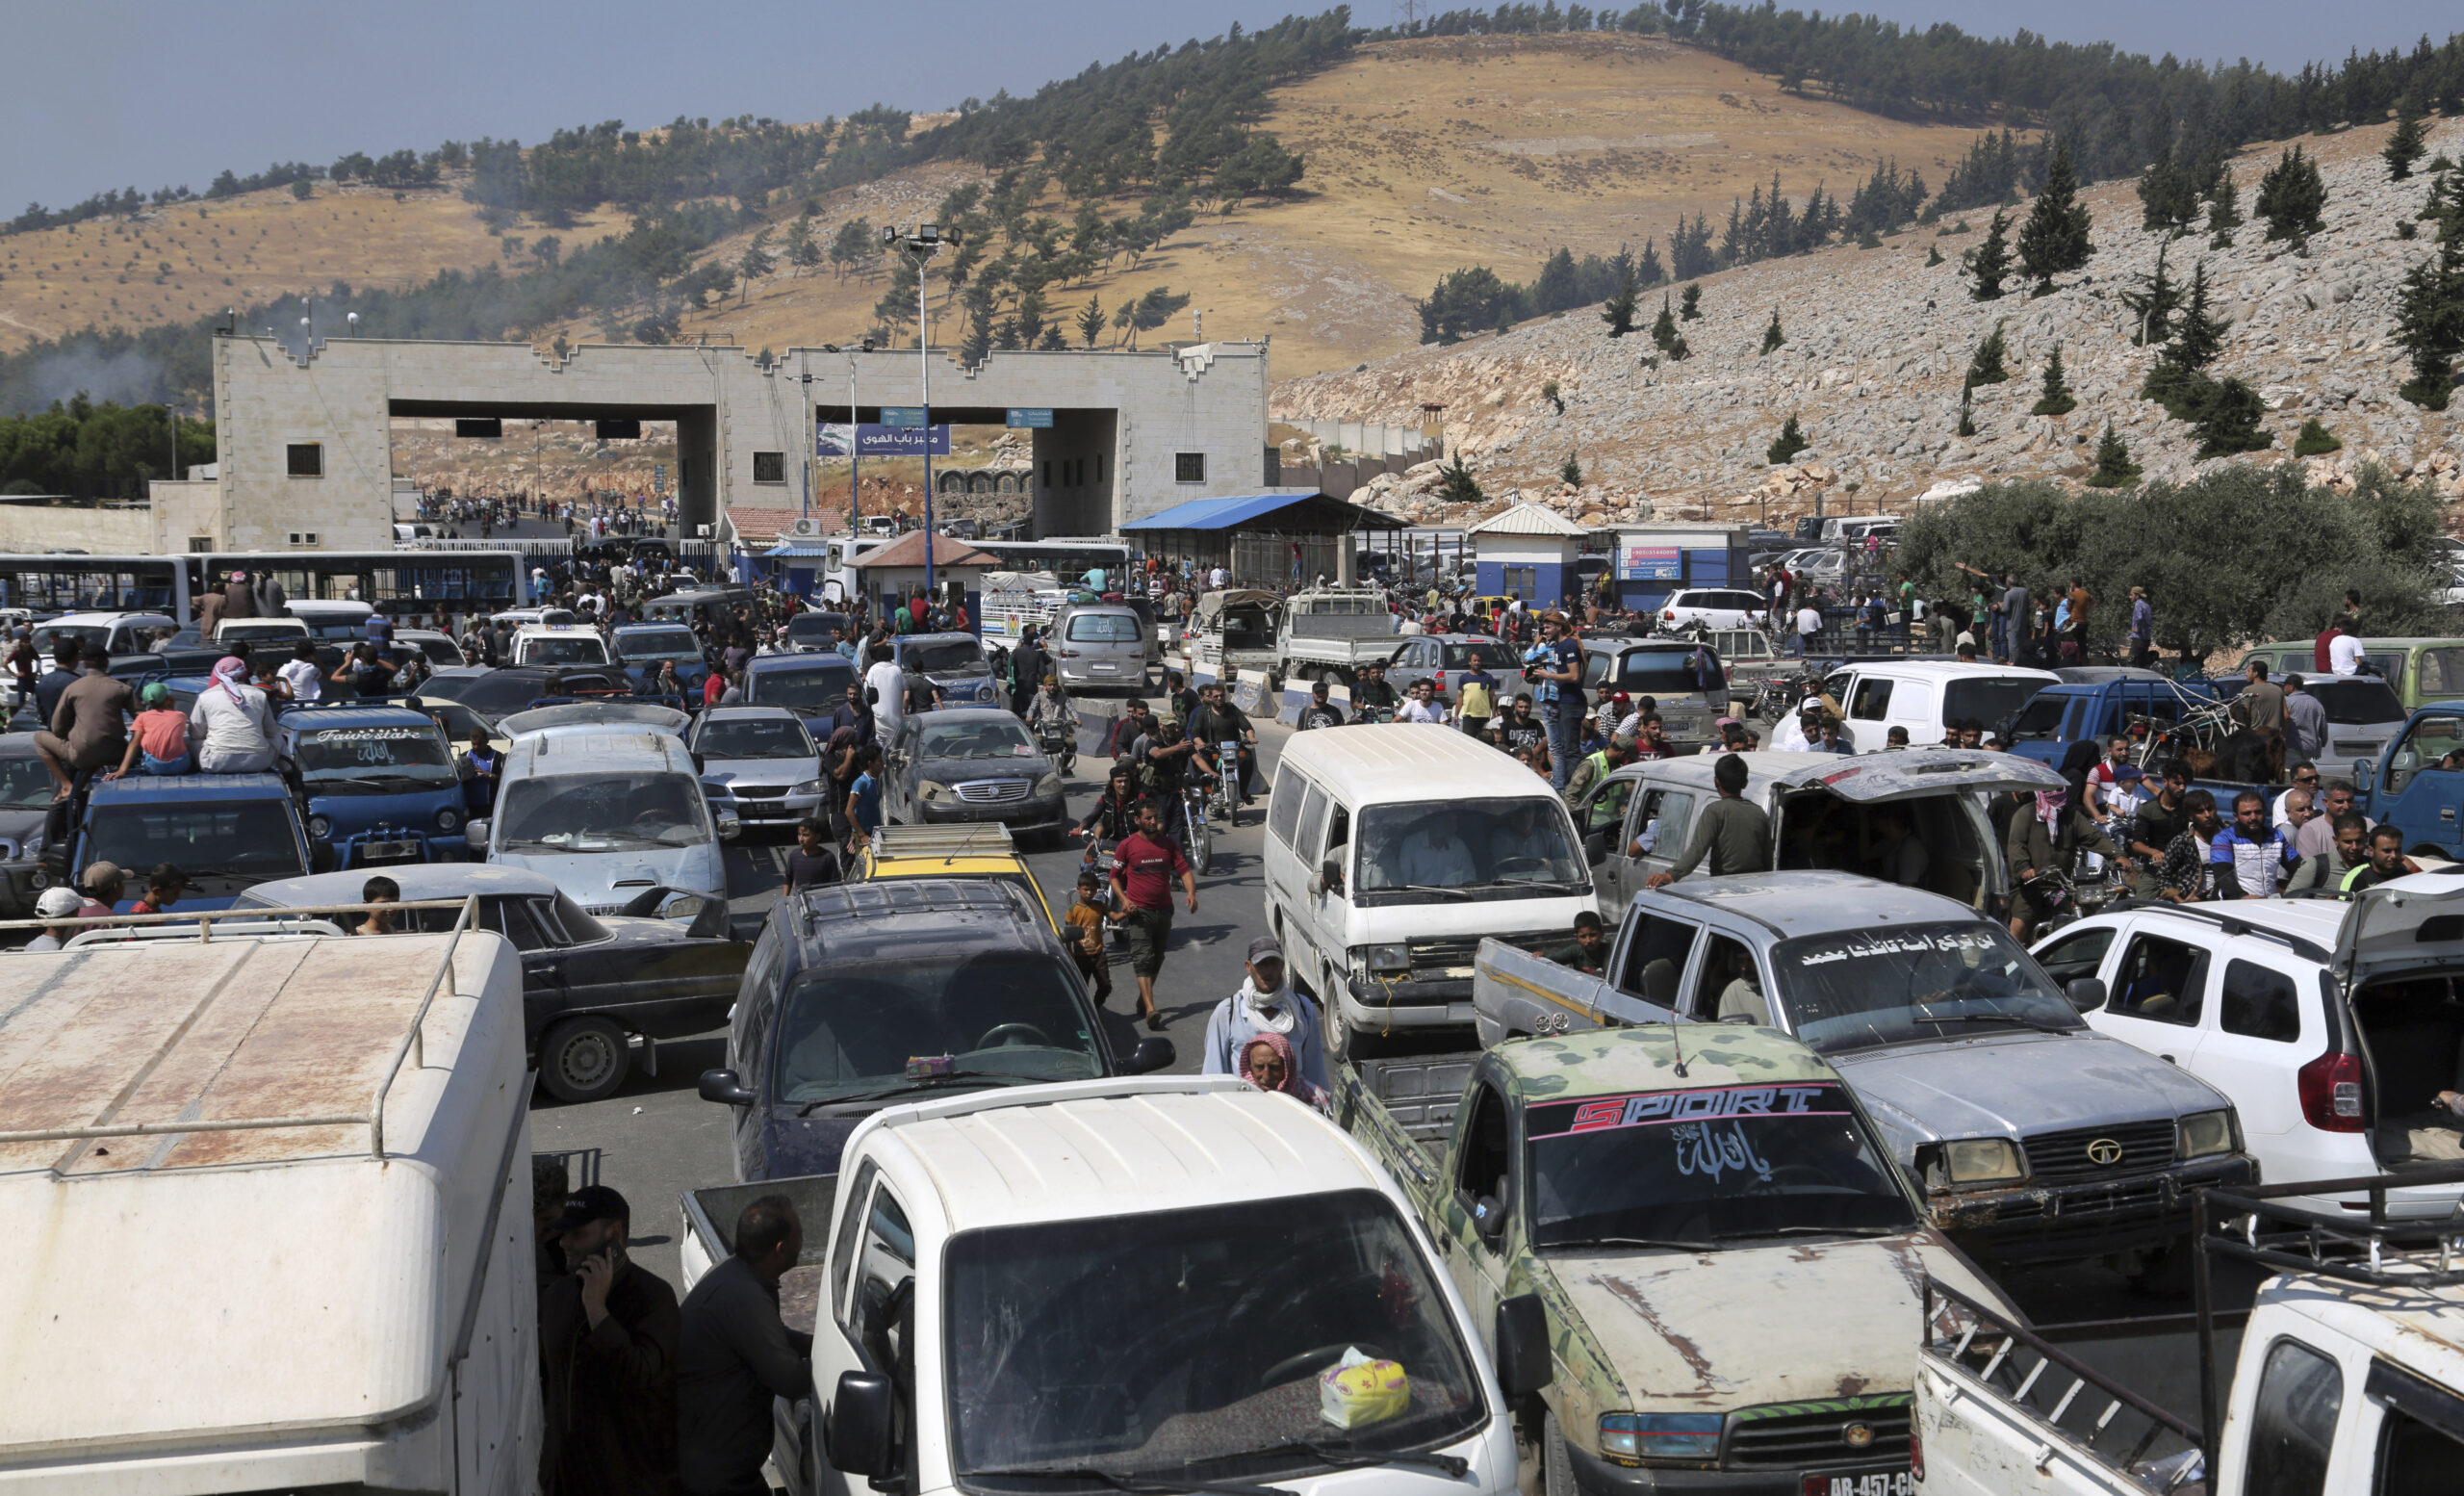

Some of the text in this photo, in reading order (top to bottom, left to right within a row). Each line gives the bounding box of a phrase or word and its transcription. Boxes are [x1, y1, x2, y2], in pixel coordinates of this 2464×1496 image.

[862, 433, 938, 445] مبر باب الهوى
[1936, 935, 1975, 951] تركع
[1977, 934, 1996, 949] لن
[1570, 1088, 1823, 1132] SPORT
